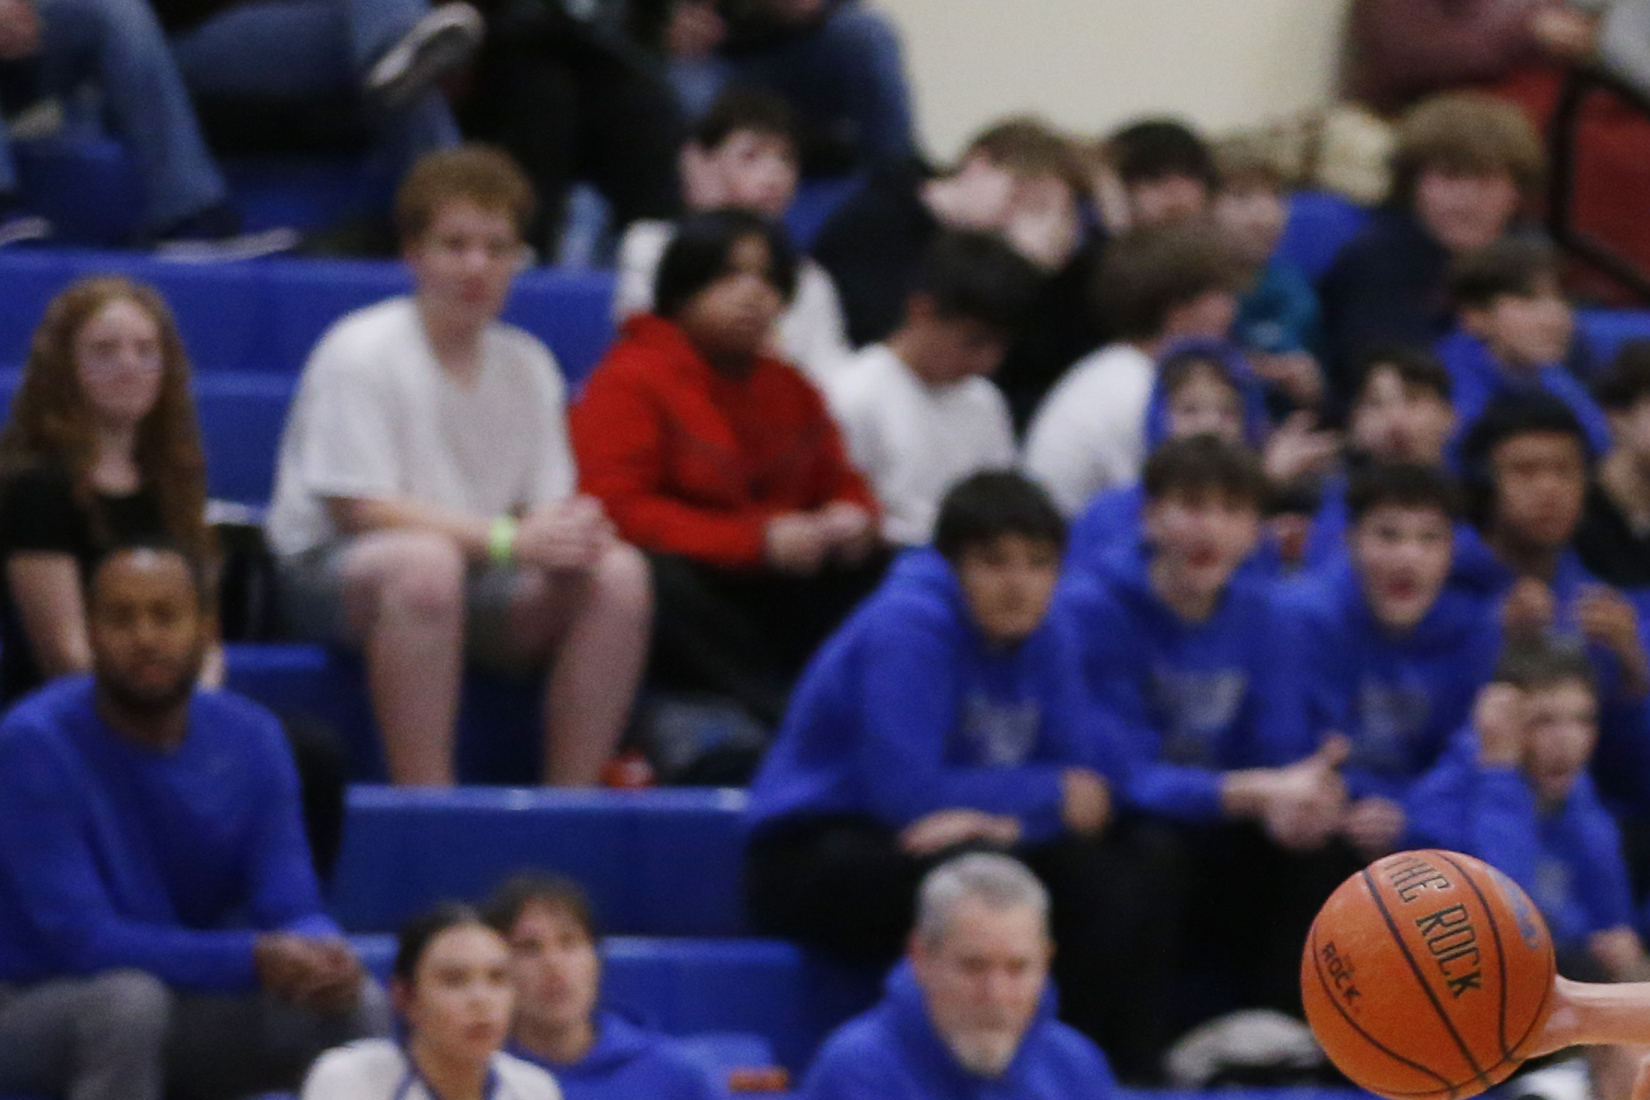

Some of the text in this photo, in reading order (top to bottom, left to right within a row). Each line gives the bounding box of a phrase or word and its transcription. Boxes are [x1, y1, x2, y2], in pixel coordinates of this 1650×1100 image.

[1321, 940, 1362, 1006] ROCK
[1383, 856, 1482, 998] THE ROCK
